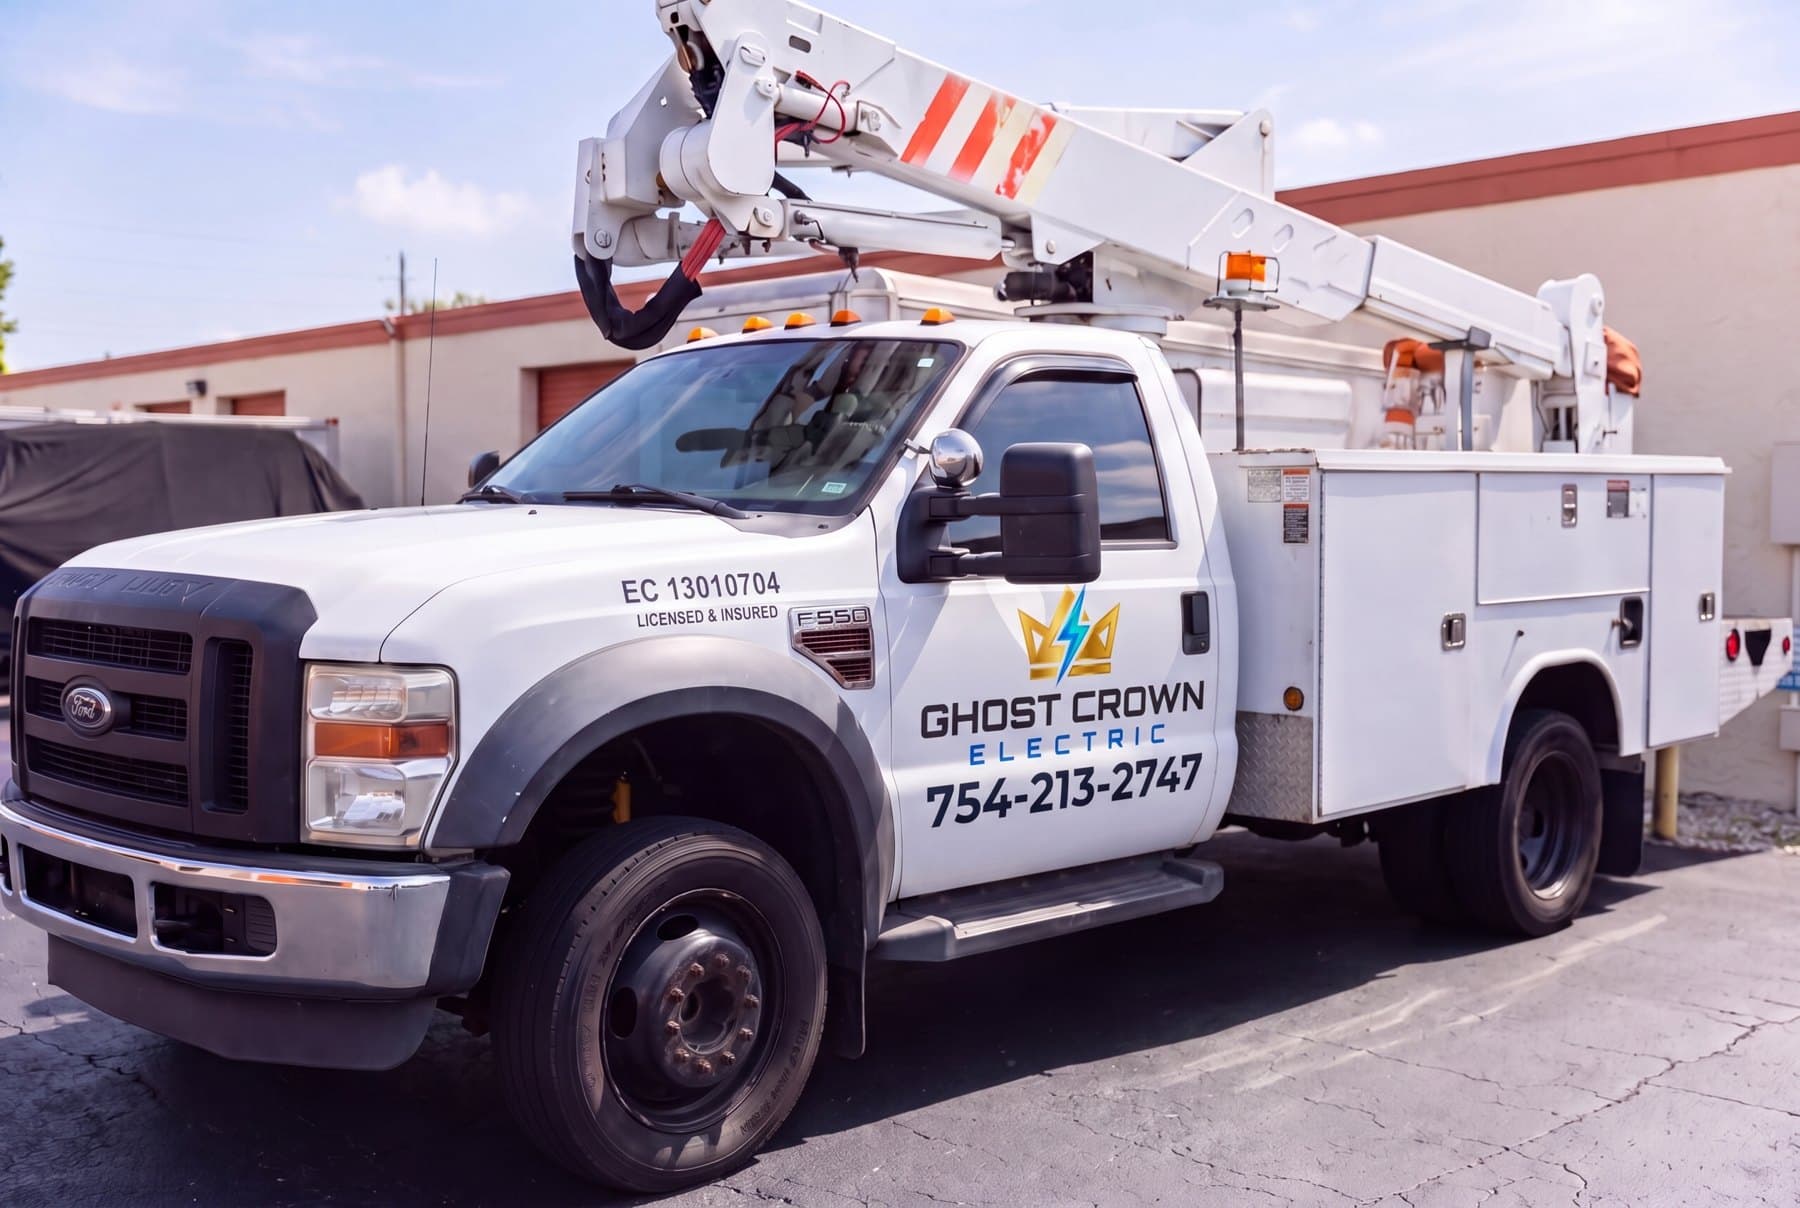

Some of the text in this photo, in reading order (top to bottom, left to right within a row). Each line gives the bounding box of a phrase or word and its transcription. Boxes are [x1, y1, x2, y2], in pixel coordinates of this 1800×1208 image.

[621, 571, 781, 604] EC 13010704
[637, 605, 779, 628] LICENSED & INSURED
[71, 693, 97, 718] Ford
[920, 680, 1205, 739] GHOST CROWN
[969, 724, 1166, 766] ELECTRIC
[926, 752, 1203, 828] 754-213-2747
